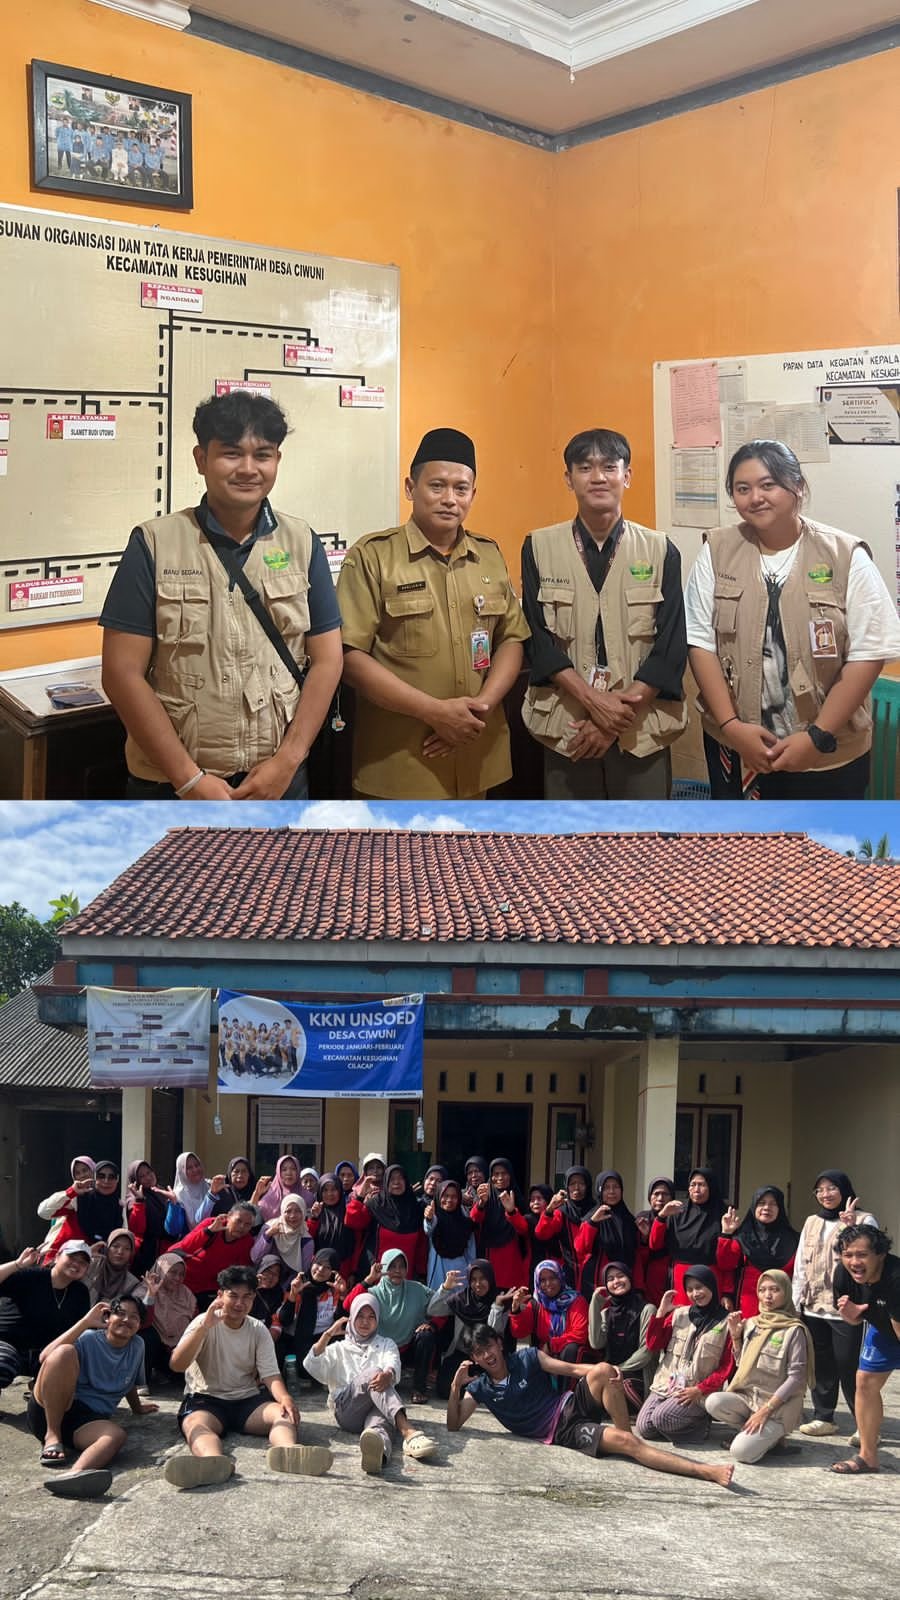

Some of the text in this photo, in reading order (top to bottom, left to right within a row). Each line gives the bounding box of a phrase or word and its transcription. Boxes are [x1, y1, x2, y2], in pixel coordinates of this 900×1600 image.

[44, 227, 116, 251] ORGANISASI
[118, 237, 141, 254] DAN
[144, 241, 170, 259] TATA
[172, 245, 205, 263] KERJA
[207, 251, 267, 273] PEMERINTAH
[269, 259, 292, 277] DESA
[294, 263, 325, 281] CIWUNI
[106, 255, 247, 287] KECAMATAN KESUGIHAN
[783, 354, 900, 371] PAPAN DATA KEGIATAN KEPALA
[825, 370, 866, 381] KECAMATAN
[309, 1010, 416, 1027] KKN UNSOED
[328, 1029, 397, 1040] DESA CIWUNI
